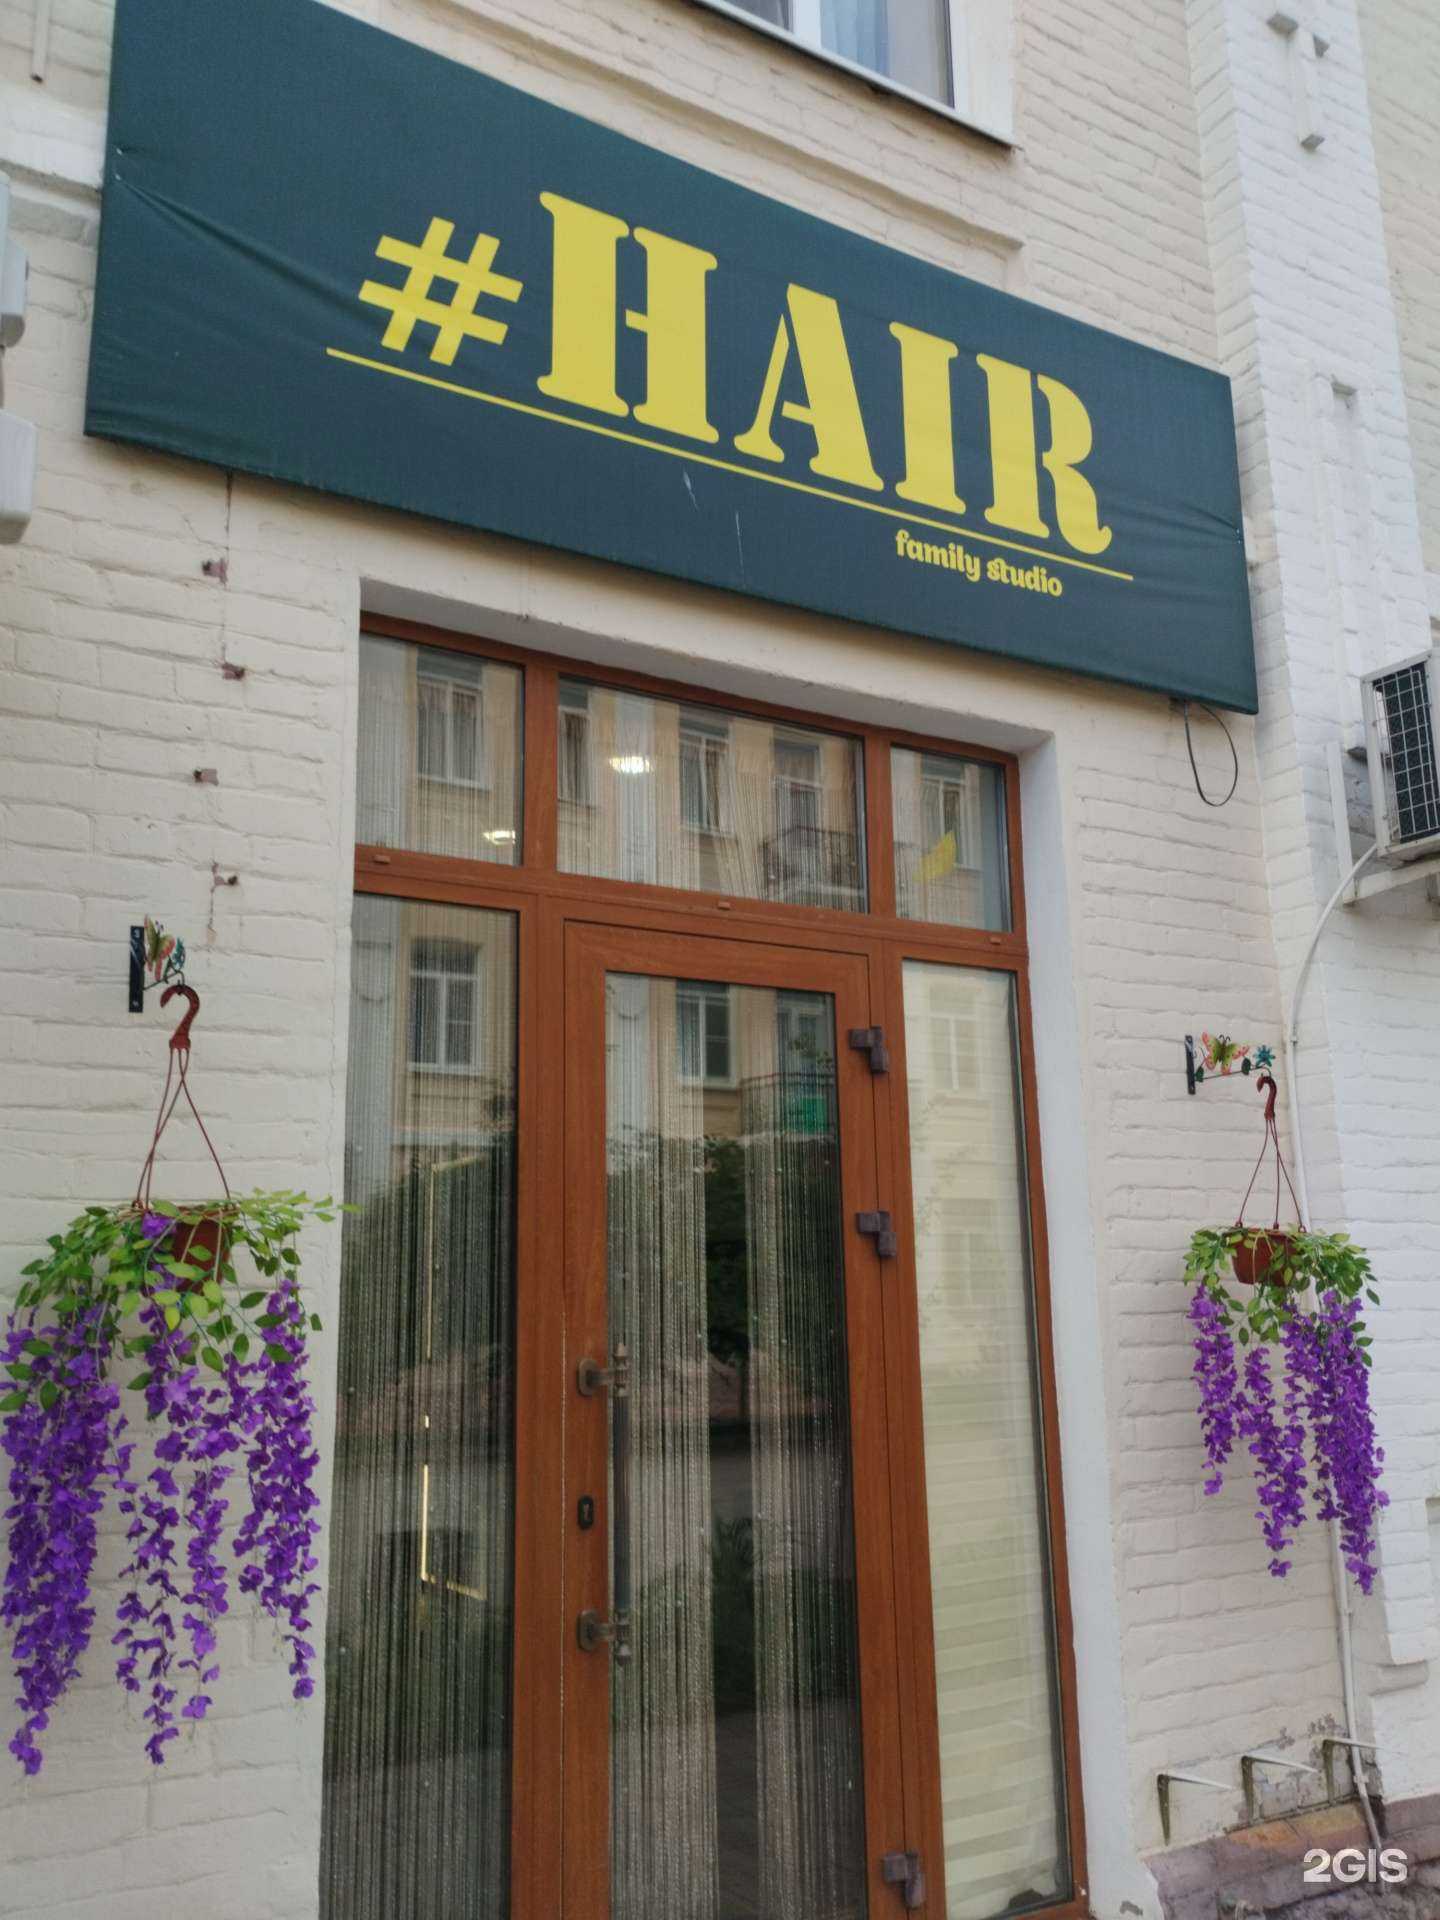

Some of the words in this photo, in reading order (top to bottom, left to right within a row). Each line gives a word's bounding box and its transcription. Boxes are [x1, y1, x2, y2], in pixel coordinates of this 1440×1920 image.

[358, 191, 1113, 555] #HAIR
[895, 529, 981, 582] family
[986, 558, 1063, 597] studio
